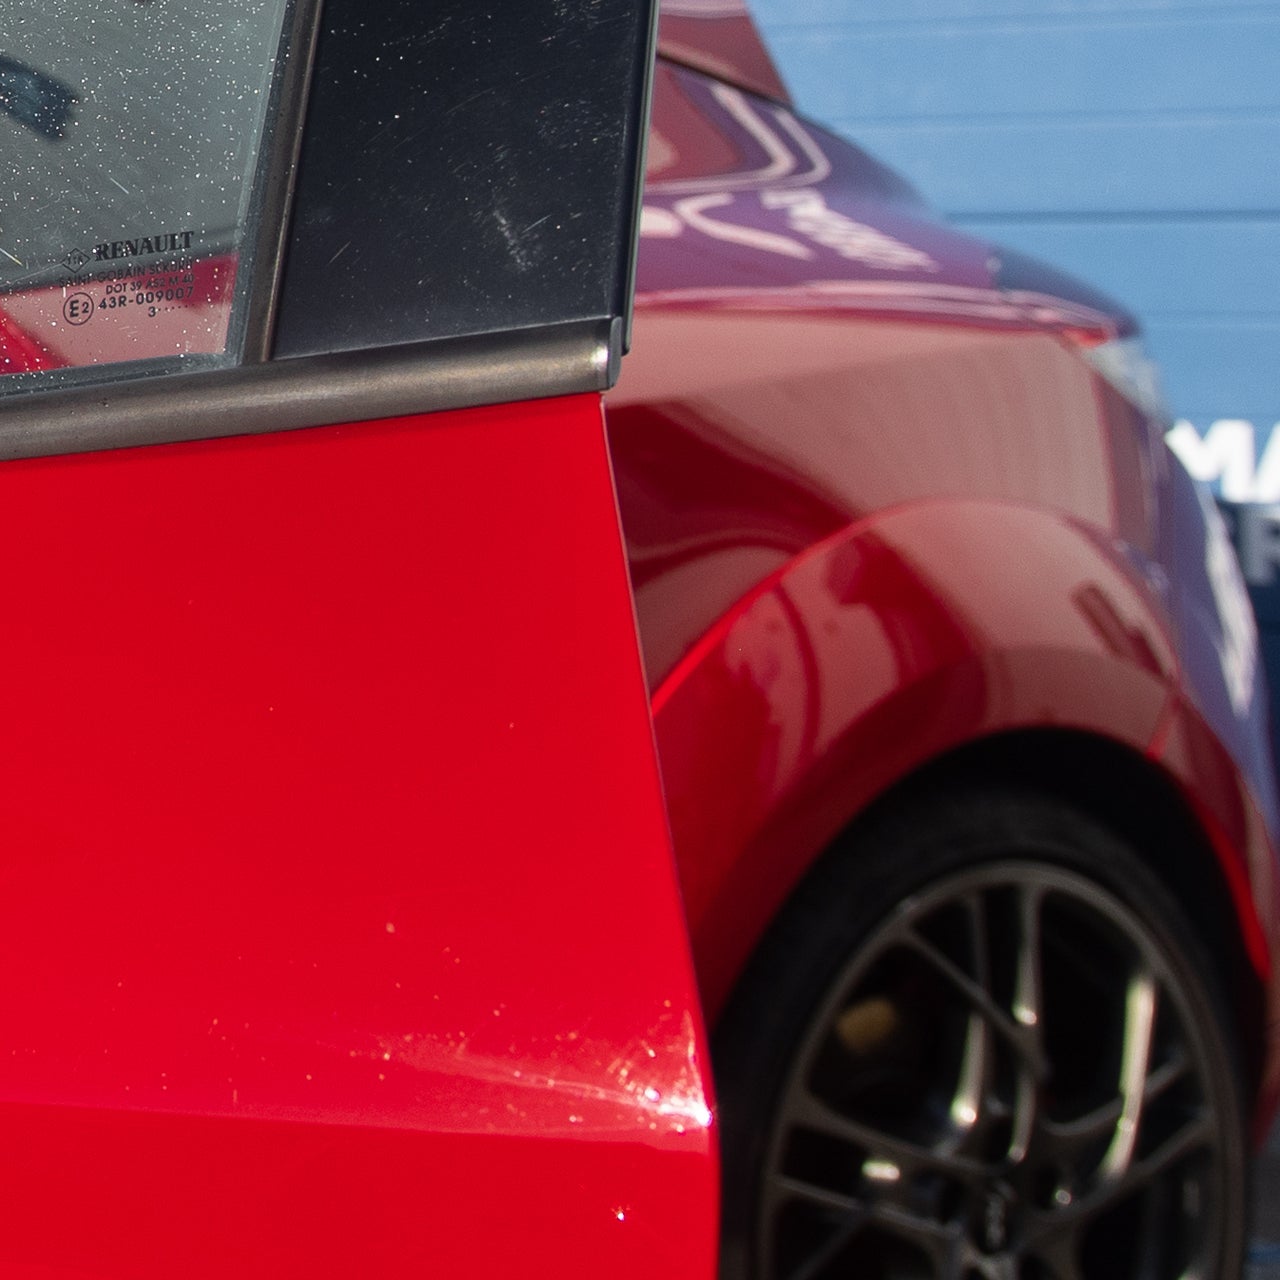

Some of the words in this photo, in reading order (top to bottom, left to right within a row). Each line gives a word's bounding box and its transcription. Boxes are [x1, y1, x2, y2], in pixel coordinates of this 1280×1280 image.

[95, 231, 194, 262] RENAULT
[99, 286, 193, 310] 43R-009007
[106, 282, 128, 295] DOT
[130, 280, 143, 292] 39
